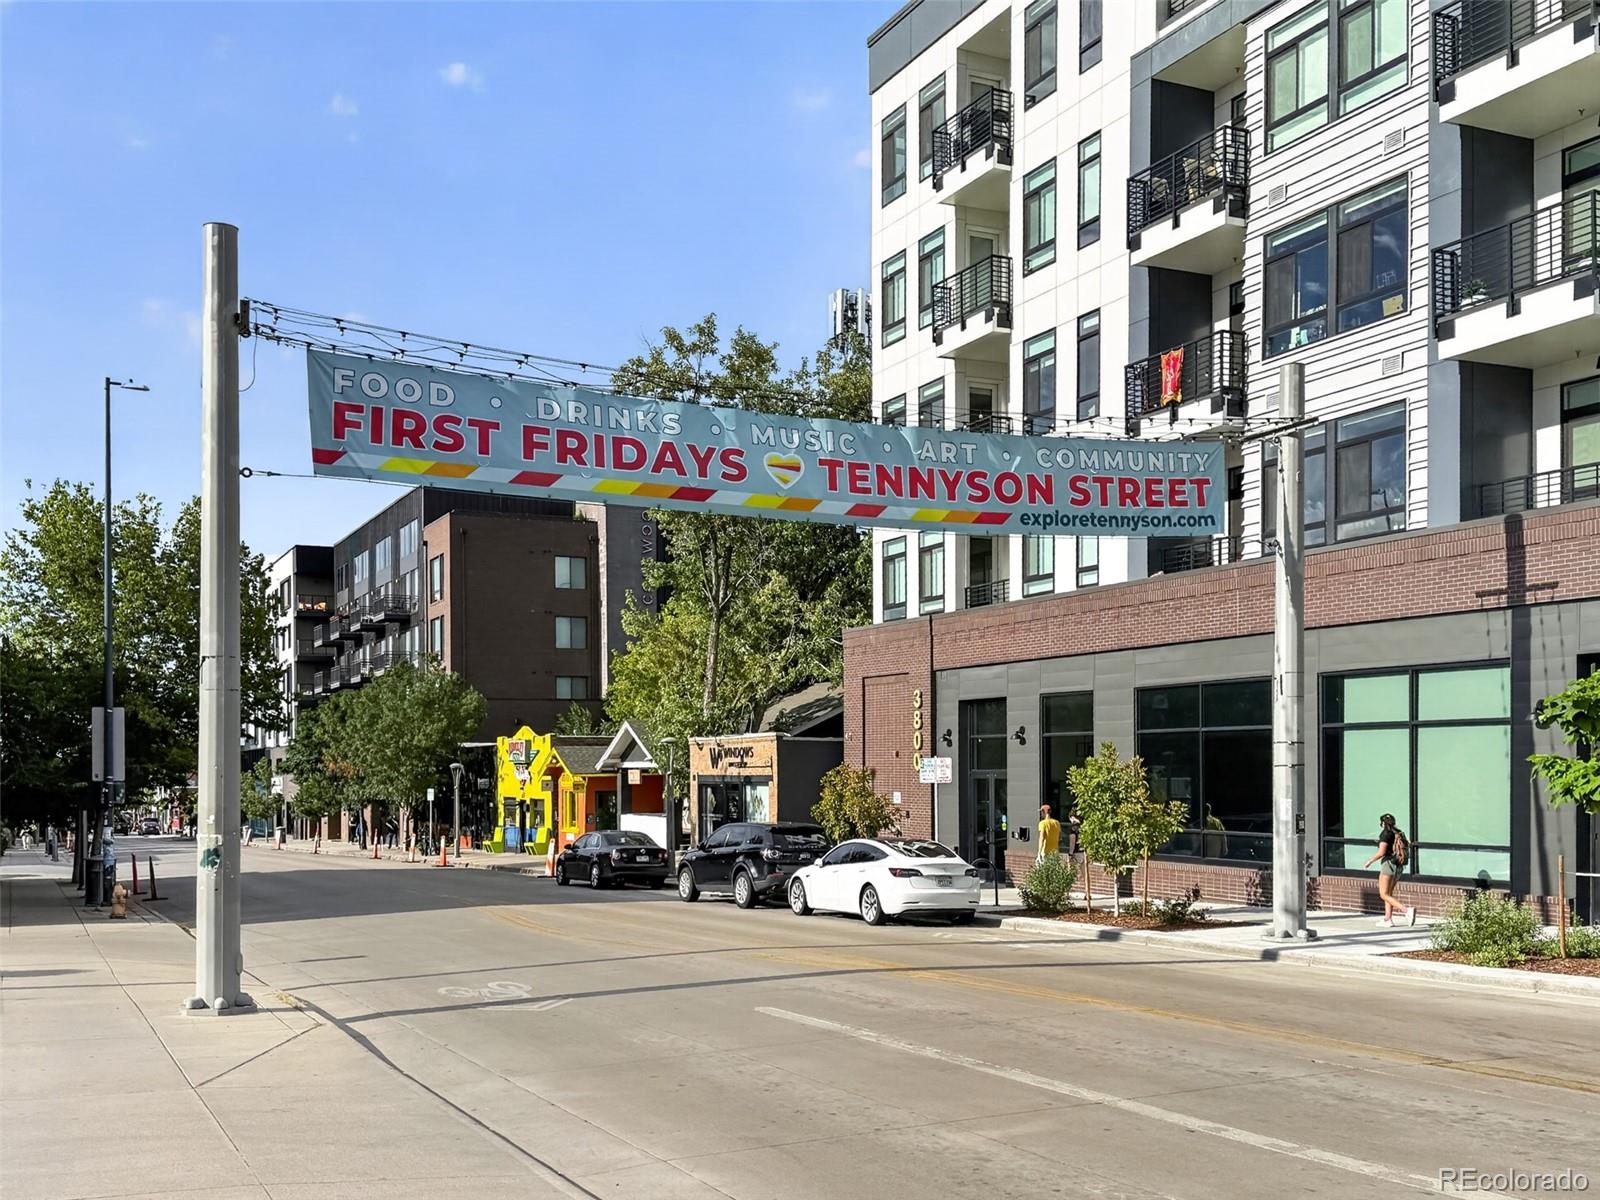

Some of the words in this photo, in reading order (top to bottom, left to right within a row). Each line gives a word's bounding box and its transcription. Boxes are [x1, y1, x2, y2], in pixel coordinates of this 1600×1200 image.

[332, 400, 501, 457] FIRST
[521, 424, 748, 482] FRIDAYS
[817, 456, 1054, 506] TENNYSON
[1068, 474, 1211, 508] STREET
[333, 367, 456, 407] FOOD
[536, 397, 682, 435] DRINKS
[751, 424, 856, 455] MUSIC
[920, 439, 977, 464] ART
[1036, 448, 1209, 472] COMMUNITY
[1020, 509, 1216, 531] exploretennyson.com
[913, 689, 922, 771] 3800
